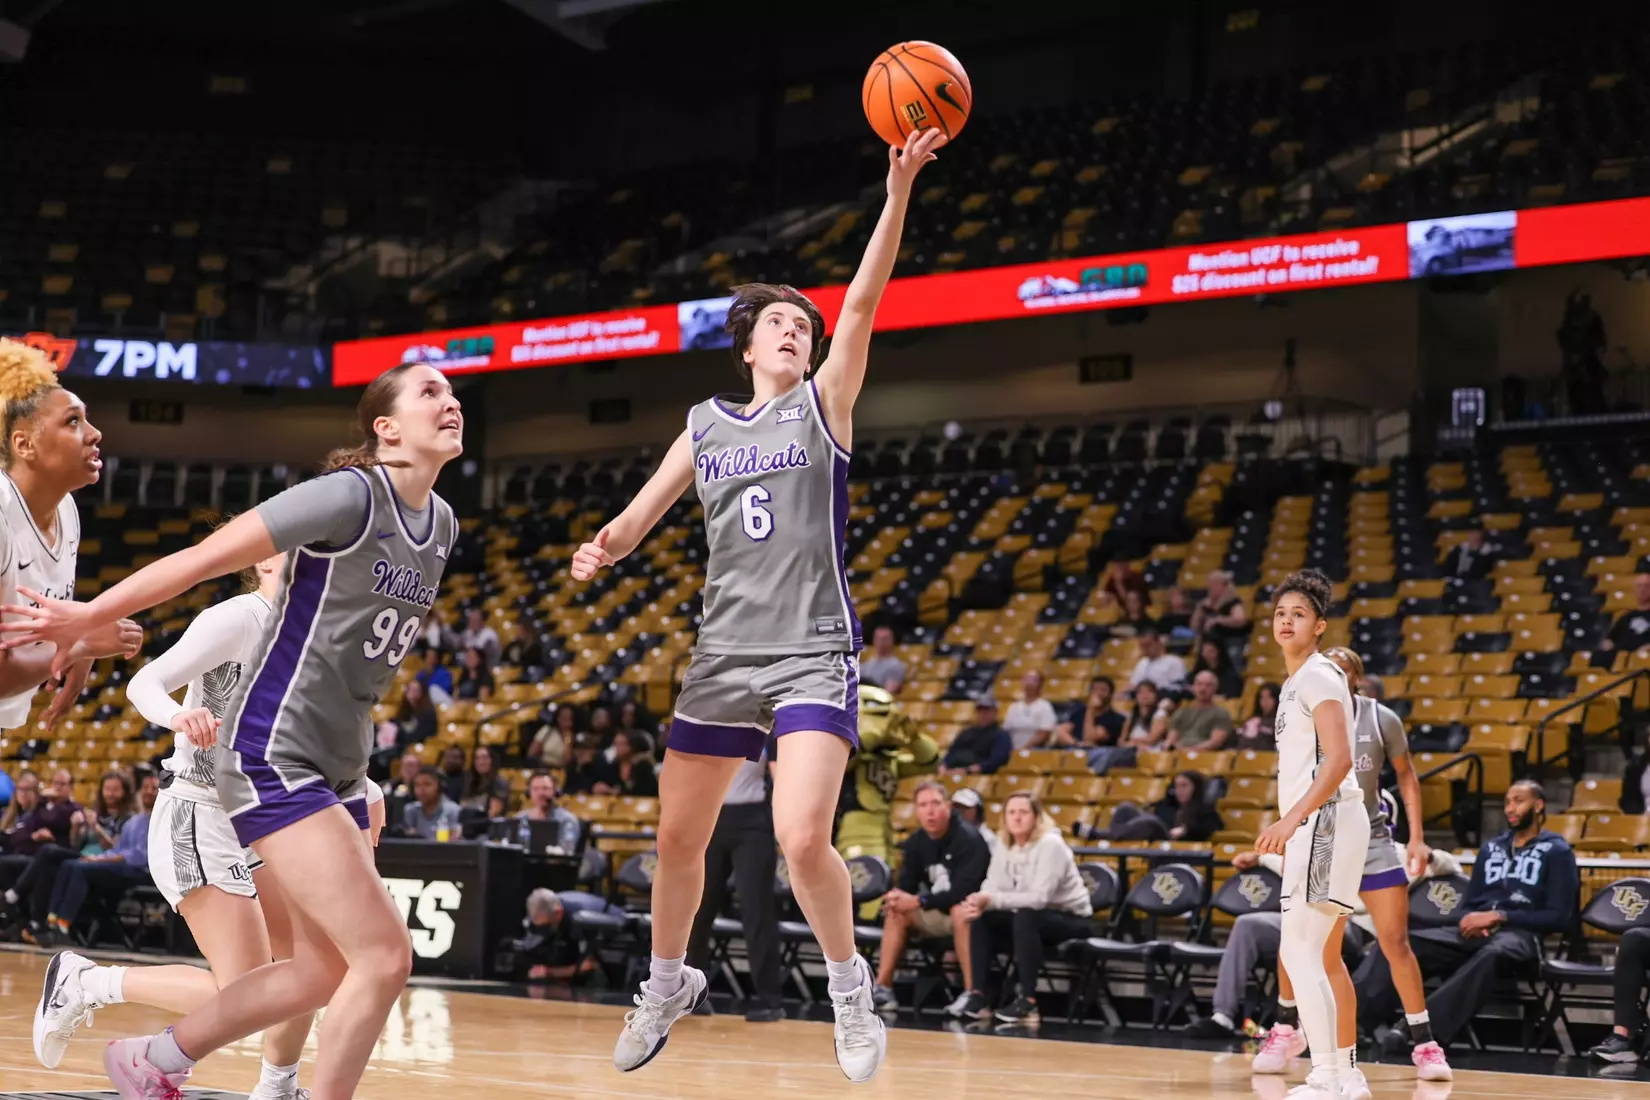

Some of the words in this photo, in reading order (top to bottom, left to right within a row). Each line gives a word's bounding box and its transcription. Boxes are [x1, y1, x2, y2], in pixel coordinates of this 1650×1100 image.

[1283, 244, 1301, 262] to
[1302, 238, 1360, 260] receive
[1201, 268, 1266, 291] discount
[1267, 268, 1288, 285] on
[94, 339, 197, 380] 7PM
[697, 438, 812, 485] Wildcats
[740, 483, 775, 542] 6
[371, 559, 441, 609] Wildca
[363, 607, 420, 668] 99
[380, 877, 462, 959] TS
[1611, 886, 1649, 921] UCF
